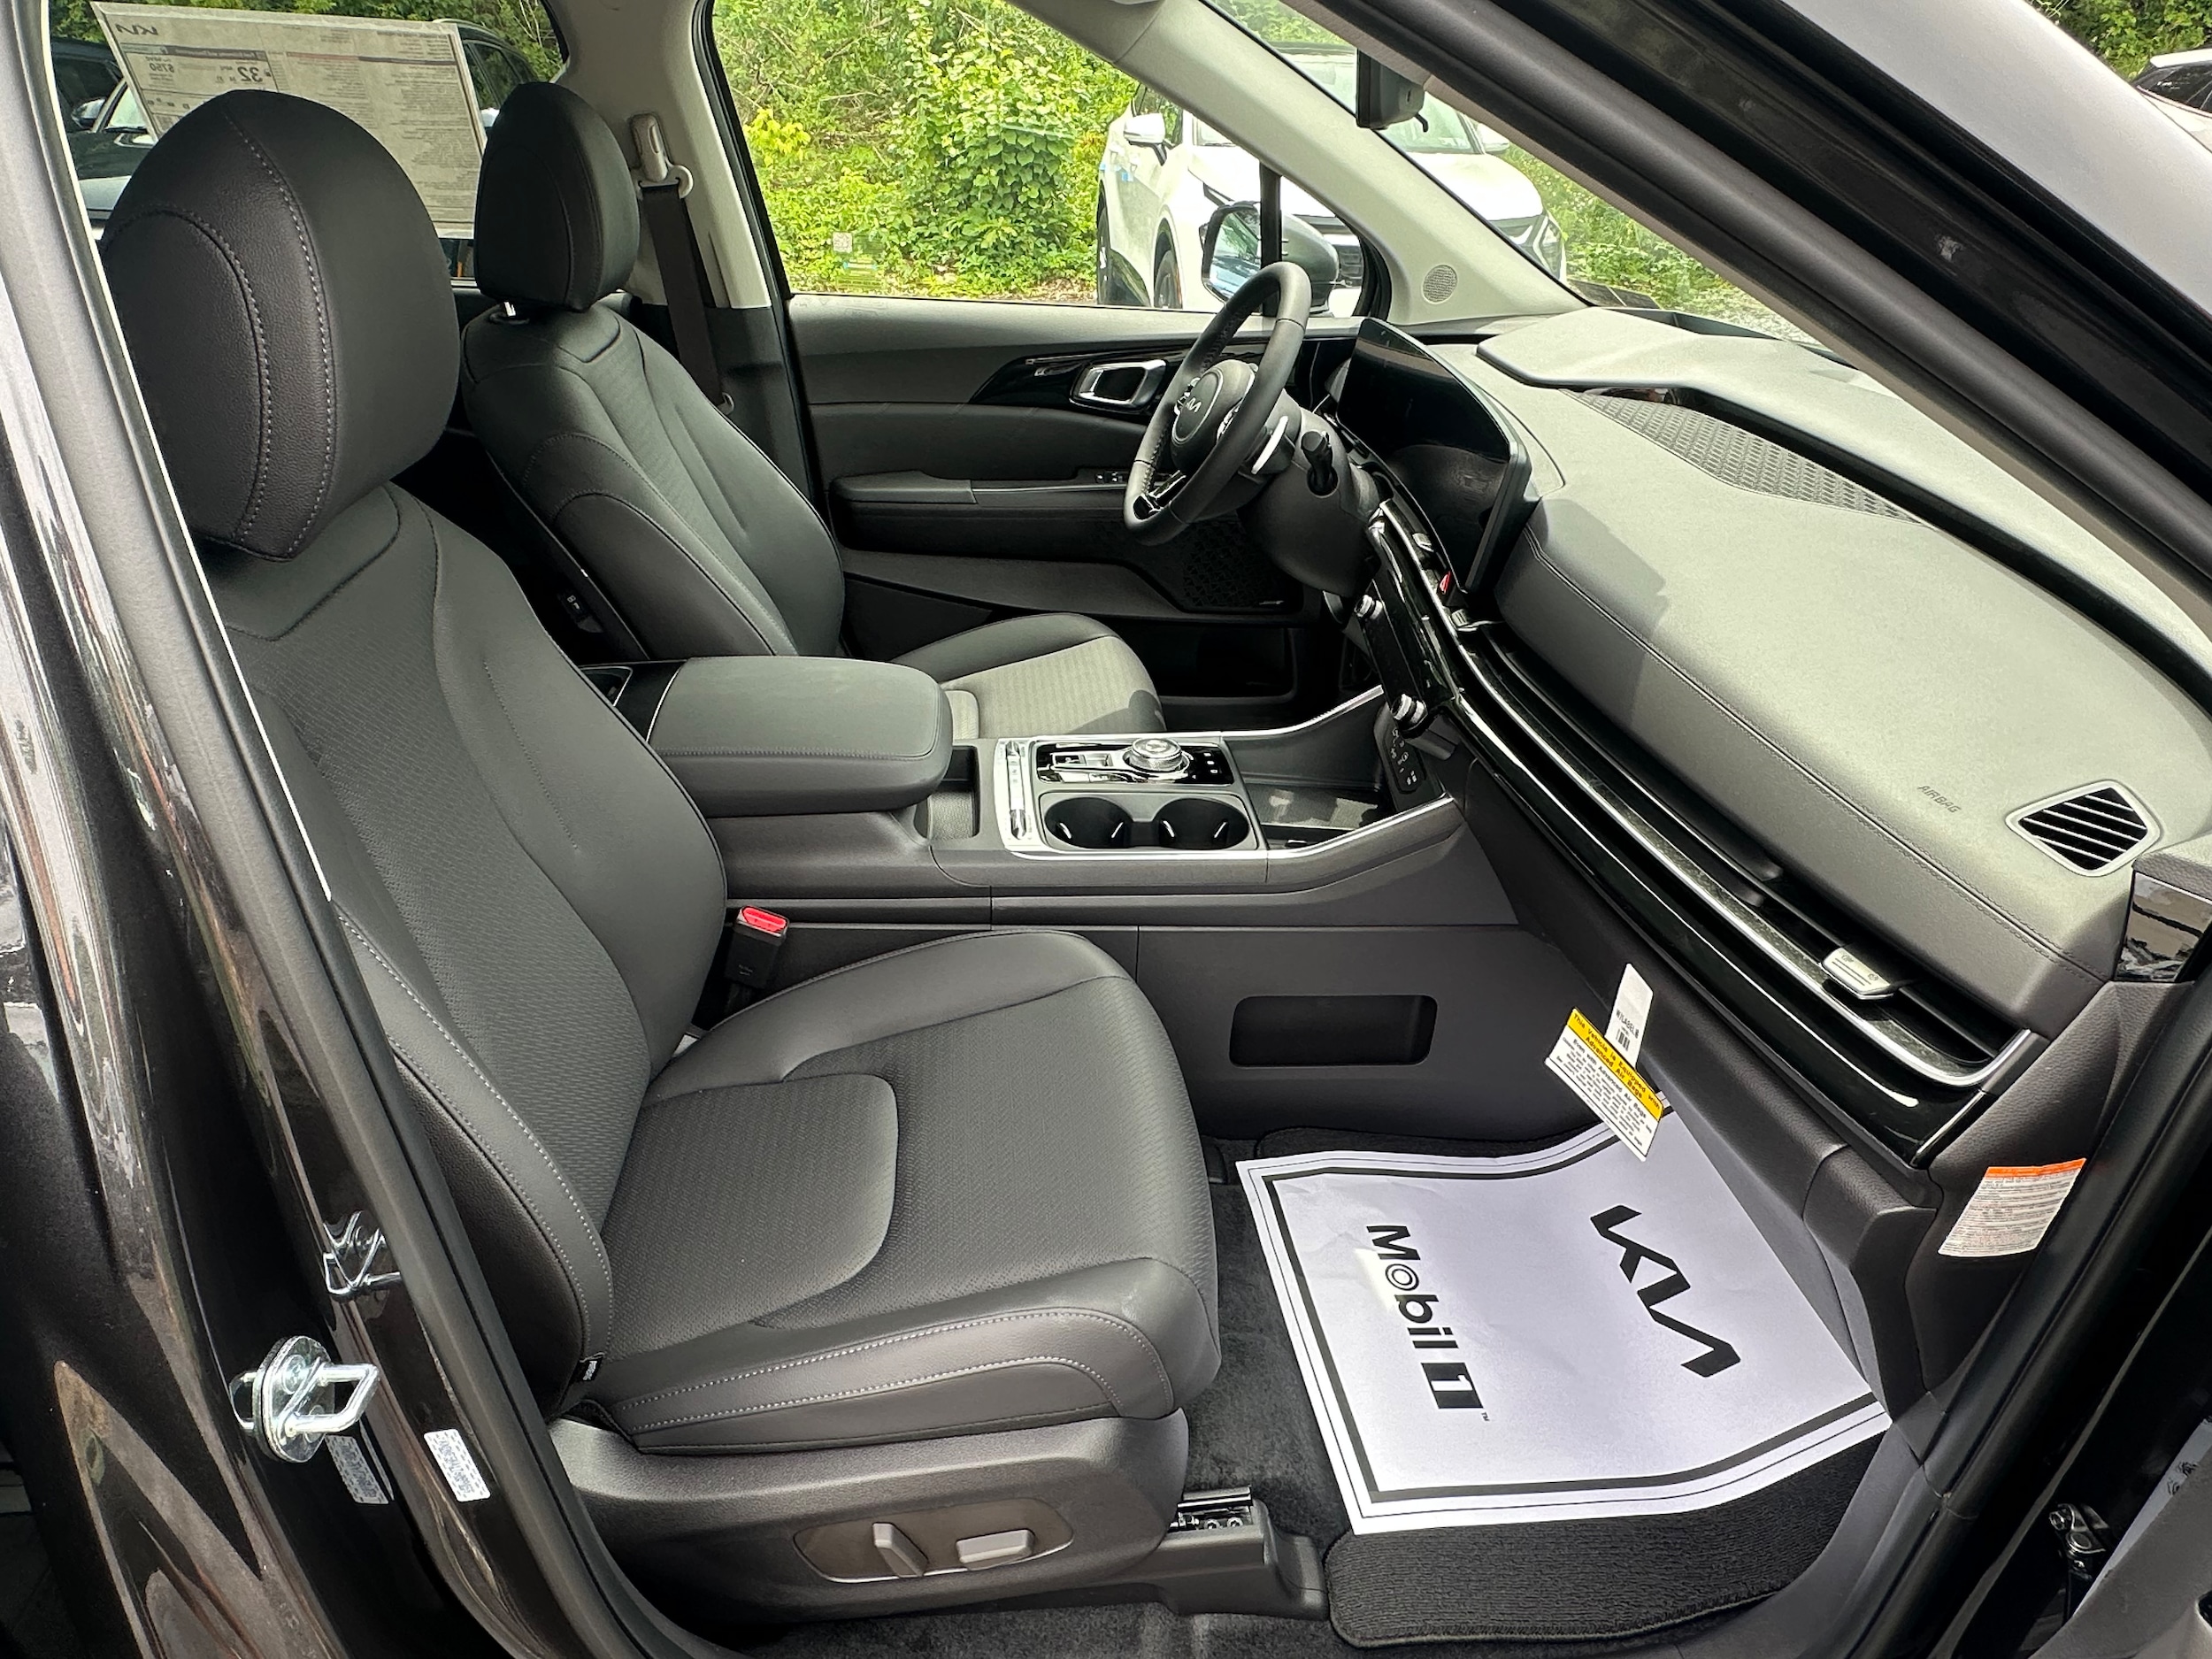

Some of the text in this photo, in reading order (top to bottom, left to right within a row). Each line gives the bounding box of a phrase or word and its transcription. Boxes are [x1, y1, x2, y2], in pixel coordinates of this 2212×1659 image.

[1916, 785, 1962, 813] AIRBAG
[1573, 1012, 1586, 1029] This
[1588, 1028, 1609, 1053] Vehicle
[1618, 1061, 1646, 1094] Equipped
[1586, 1036, 1614, 1068] Advanced
[1627, 1079, 1643, 1099] Bags
[1598, 1065, 1623, 1093] Advanced
[1366, 1225, 1459, 1349] Mobil
[1590, 1205, 1740, 1378] KIA
